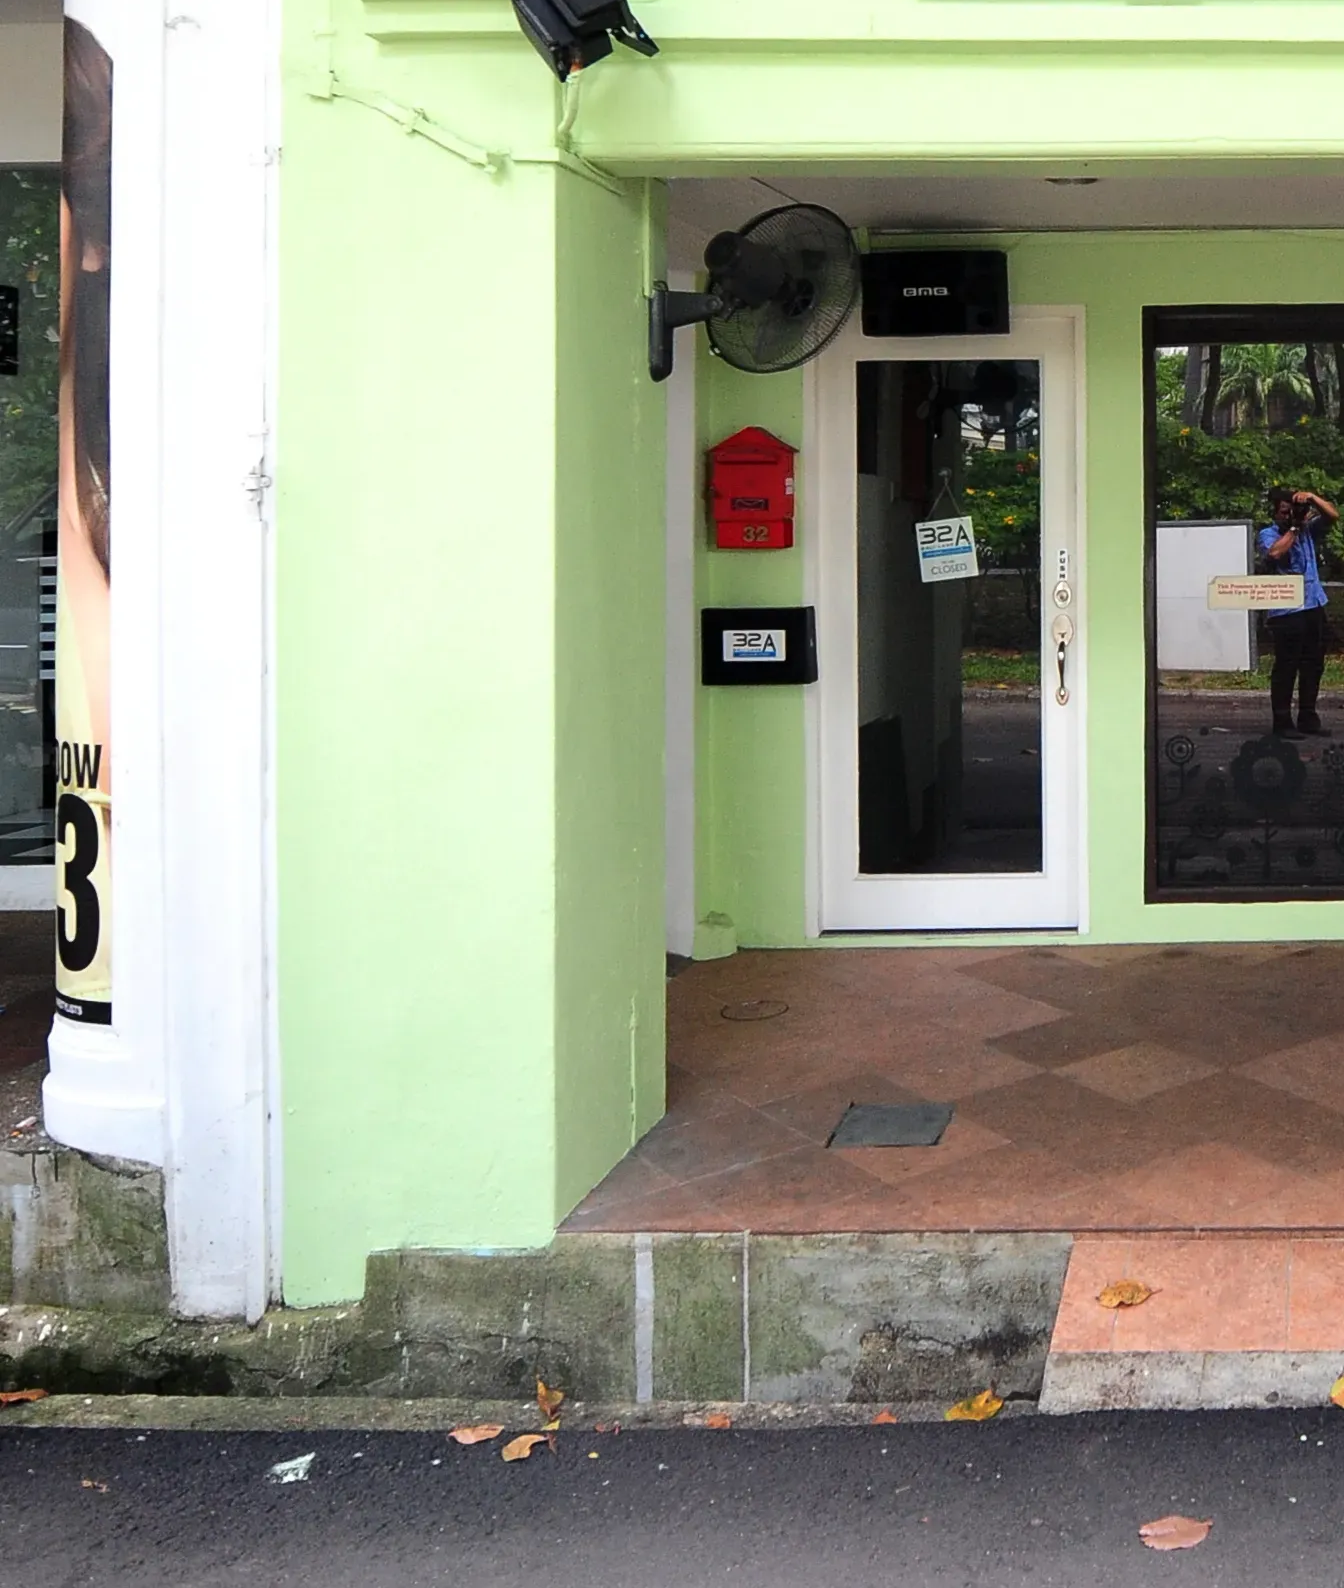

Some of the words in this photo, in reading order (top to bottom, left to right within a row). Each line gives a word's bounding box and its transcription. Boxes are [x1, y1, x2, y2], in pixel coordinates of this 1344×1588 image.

[742, 524, 770, 543] 32
[918, 523, 971, 546] 32A
[930, 562, 968, 576] CLOSED
[732, 632, 777, 653] 32A
